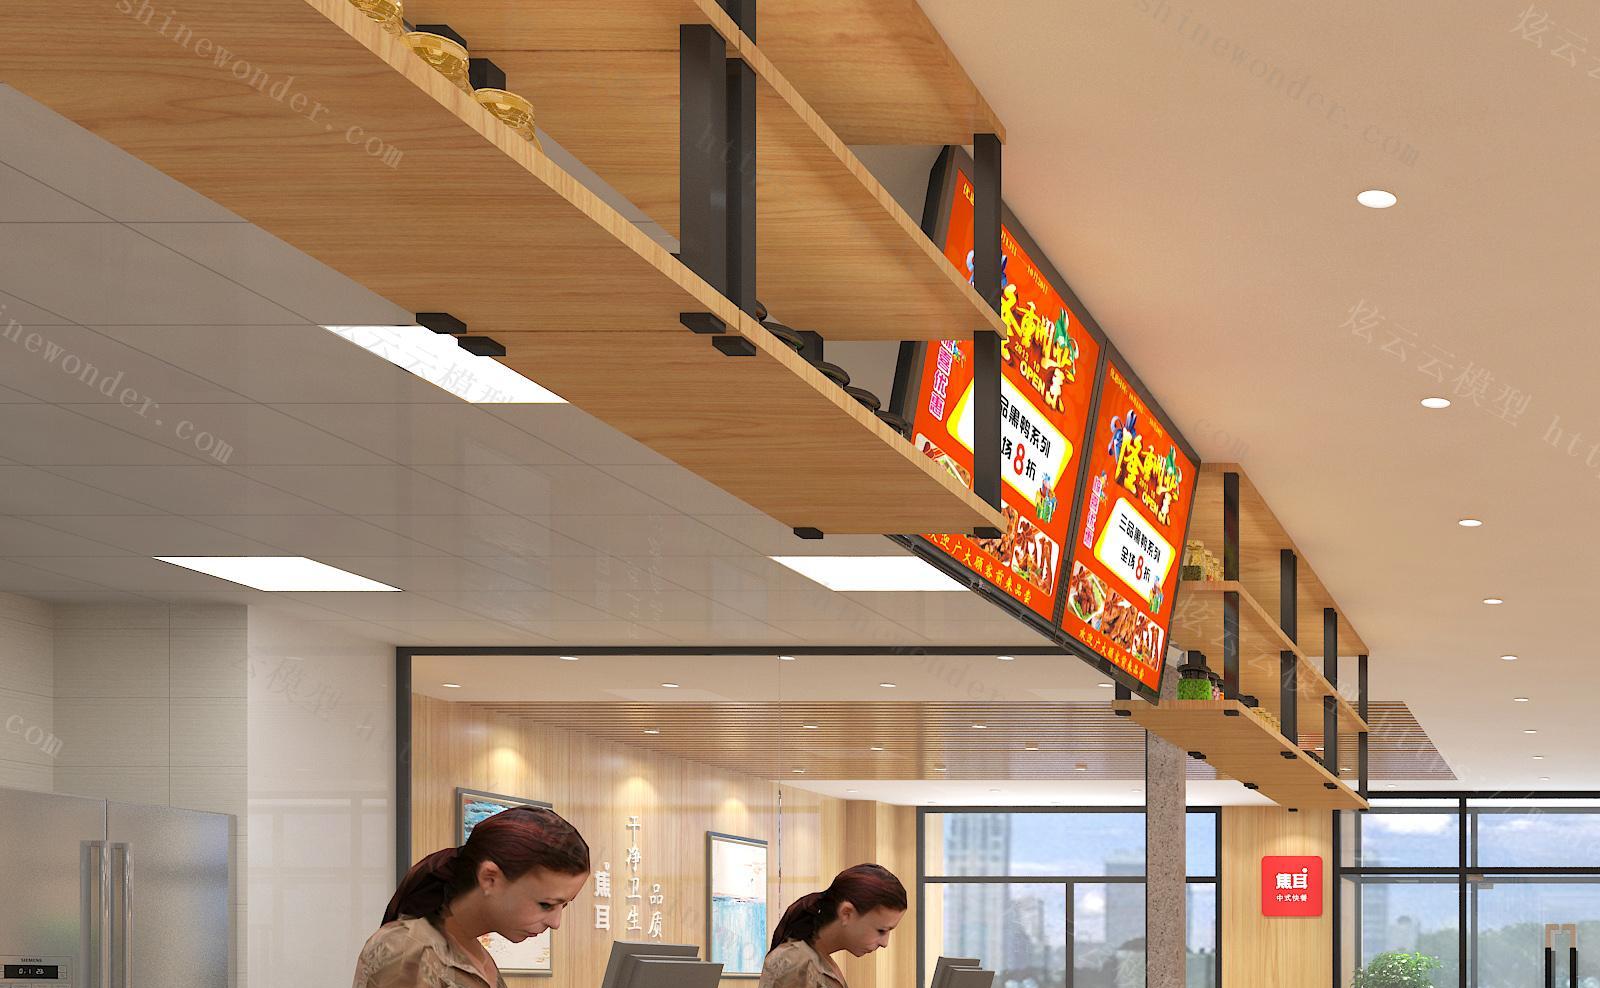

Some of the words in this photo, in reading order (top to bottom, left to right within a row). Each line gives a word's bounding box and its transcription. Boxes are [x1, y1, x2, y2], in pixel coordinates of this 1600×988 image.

[1020, 360, 1045, 396] OPEN
[1001, 394, 1051, 458] 品黑鸭系列
[1001, 436, 1037, 481] 场8折
[1142, 491, 1159, 517] OPEN
[1118, 513, 1161, 563] 三品黑鸭系列
[626, 816, 641, 930] 干净卫生
